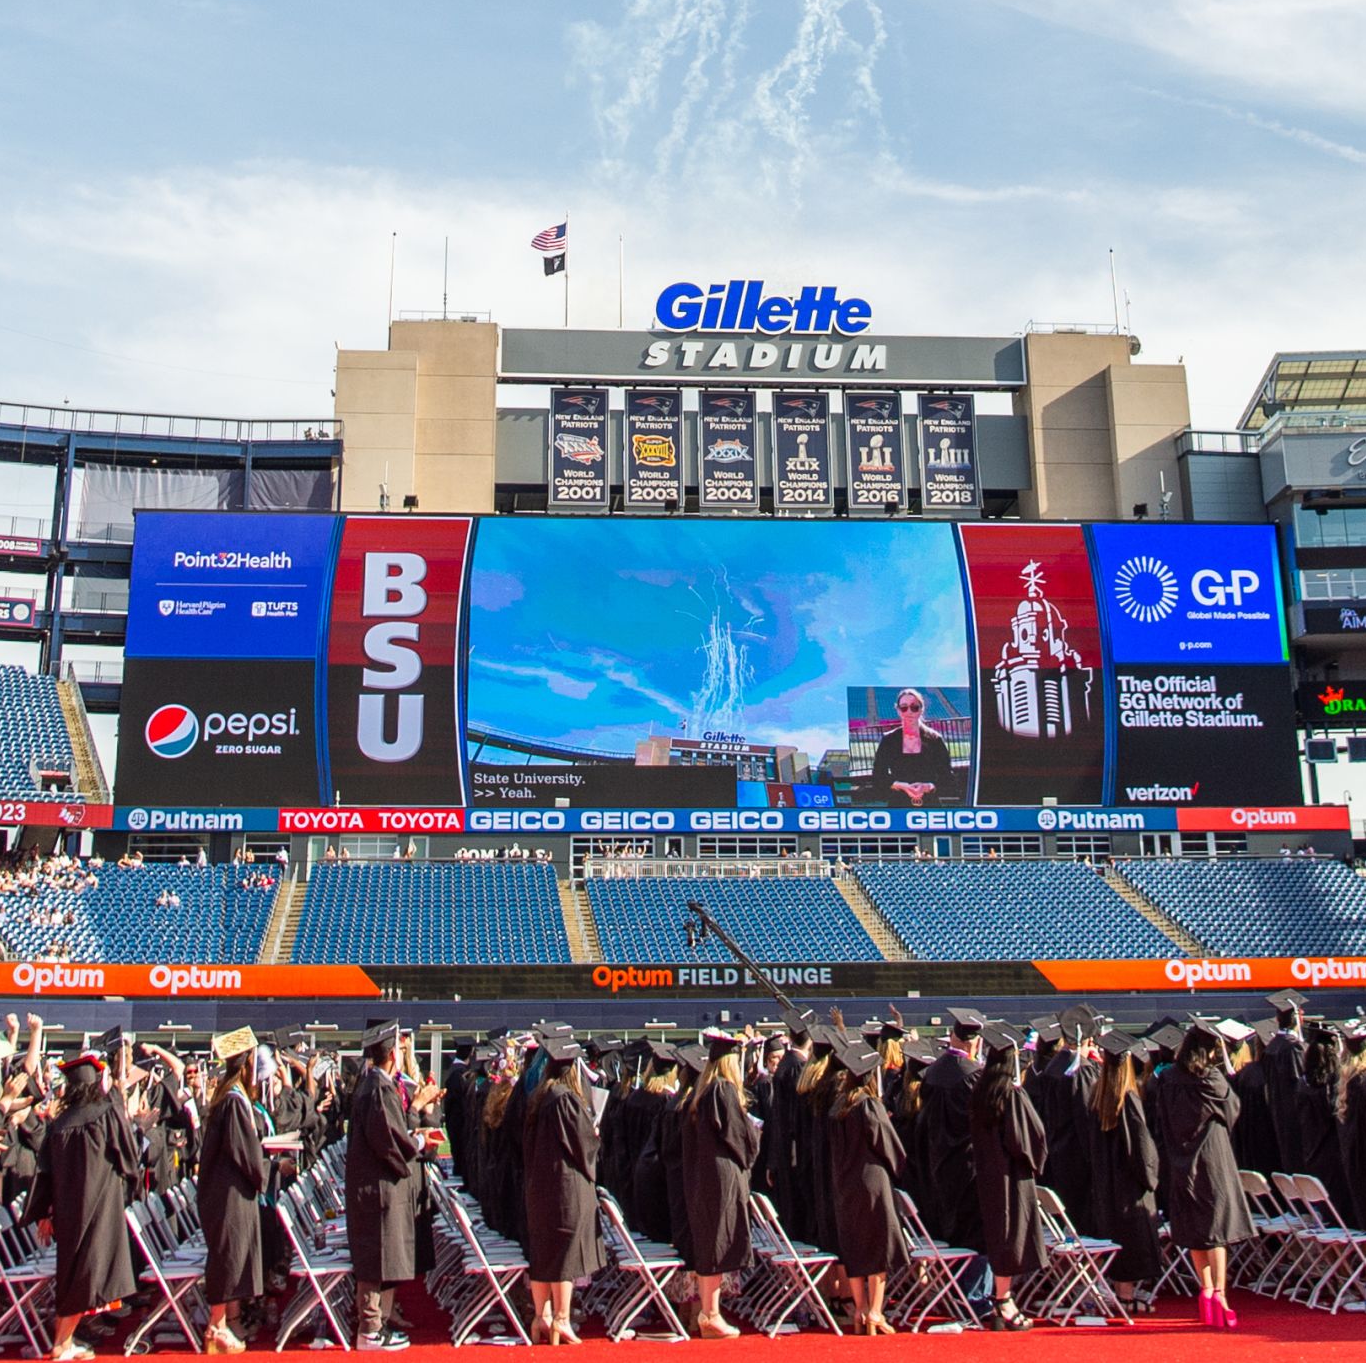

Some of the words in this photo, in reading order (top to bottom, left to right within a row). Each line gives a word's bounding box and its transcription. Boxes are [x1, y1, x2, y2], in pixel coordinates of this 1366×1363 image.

[654, 279, 874, 334] Gillette
[644, 340, 887, 370] STADIUM
[561, 421, 598, 429] PATRIOTS
[857, 425, 893, 433] PATRIOTS
[785, 461, 821, 471] XLIX
[563, 470, 595, 478] WORLD
[639, 471, 670, 479] WORLD
[713, 471, 745, 479] WORLD
[788, 473, 818, 481] WORLD
[555, 478, 603, 487] CHAMPIONS
[630, 479, 679, 487] CHAMPIONS
[705, 479, 753, 487] CHAMPIONS
[779, 481, 827, 489] CHAMPIONS
[927, 482, 975, 490] CHAMPIONS
[558, 487, 601, 500] 2001
[631, 487, 678, 501] 2003
[706, 488, 753, 501] 2004
[783, 489, 825, 501] 2014
[857, 490, 899, 503] 2016
[931, 491, 971, 503] 2018
[174, 551, 292, 569] Point32Health
[267, 602, 299, 611] TUFTS
[357, 551, 428, 763] BSU
[1117, 675, 1153, 692] The
[1154, 675, 1217, 693] Official
[1119, 693, 1147, 709] 5G
[1148, 693, 1223, 709] Network
[1225, 693, 1243, 709] of
[1121, 710, 1183, 727] Gillette
[1185, 710, 1263, 727] Stadium.
[215, 745, 243, 755] ZERO
[245, 745, 281, 755] SUGAR
[699, 743, 749, 752] STADIUM
[473, 773, 509, 785] State
[513, 773, 586, 787] University.
[499, 787, 536, 799] Yeah.
[1125, 783, 1193, 801] verizon
[149, 811, 243, 829] Putnam
[281, 811, 364, 829] TOYOTA
[379, 812, 461, 829] TOYOTA
[469, 811, 565, 830] GEICO
[580, 811, 675, 829] GEICO
[689, 811, 783, 829] GEICO
[799, 811, 891, 830] GEICO
[906, 811, 999, 829] GEICO
[1058, 810, 1145, 829] Putnam
[1231, 808, 1297, 829] Optum
[13, 963, 105, 994] Optum
[149, 965, 241, 994] Optum
[592, 966, 673, 993] Optum
[678, 968, 739, 985] FIELD
[1165, 959, 1251, 988] Optum
